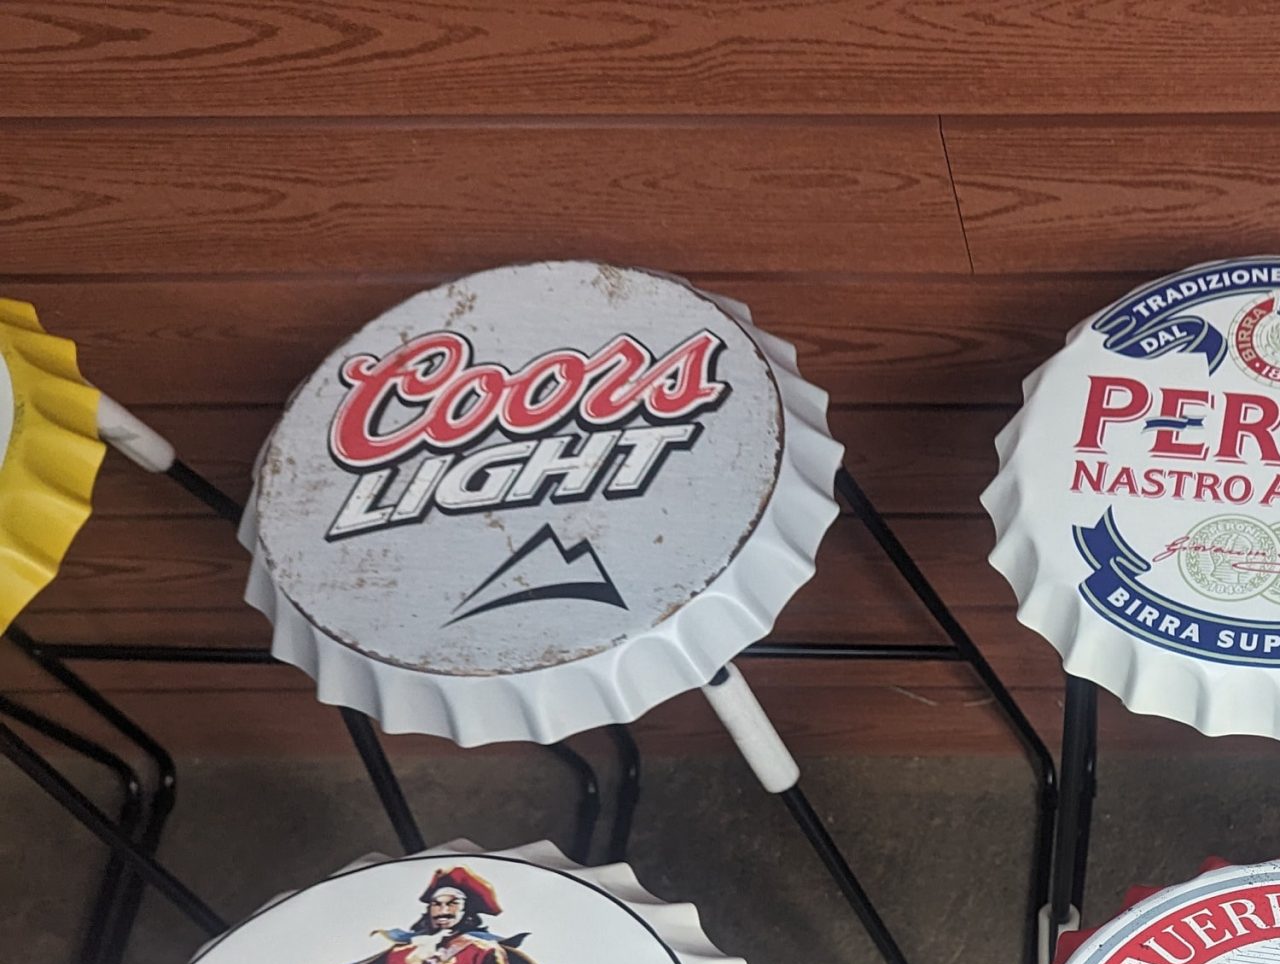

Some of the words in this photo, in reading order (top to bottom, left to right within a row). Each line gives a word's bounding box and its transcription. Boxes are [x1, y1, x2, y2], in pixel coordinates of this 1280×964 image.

[1140, 324, 1187, 353] DAL
[1238, 308, 1267, 361] BIRRA
[328, 328, 733, 475] Coors
[324, 422, 705, 543] LIGHT
[1070, 460, 1254, 503] NASTRO
[1106, 586, 1201, 643] BIRRA
